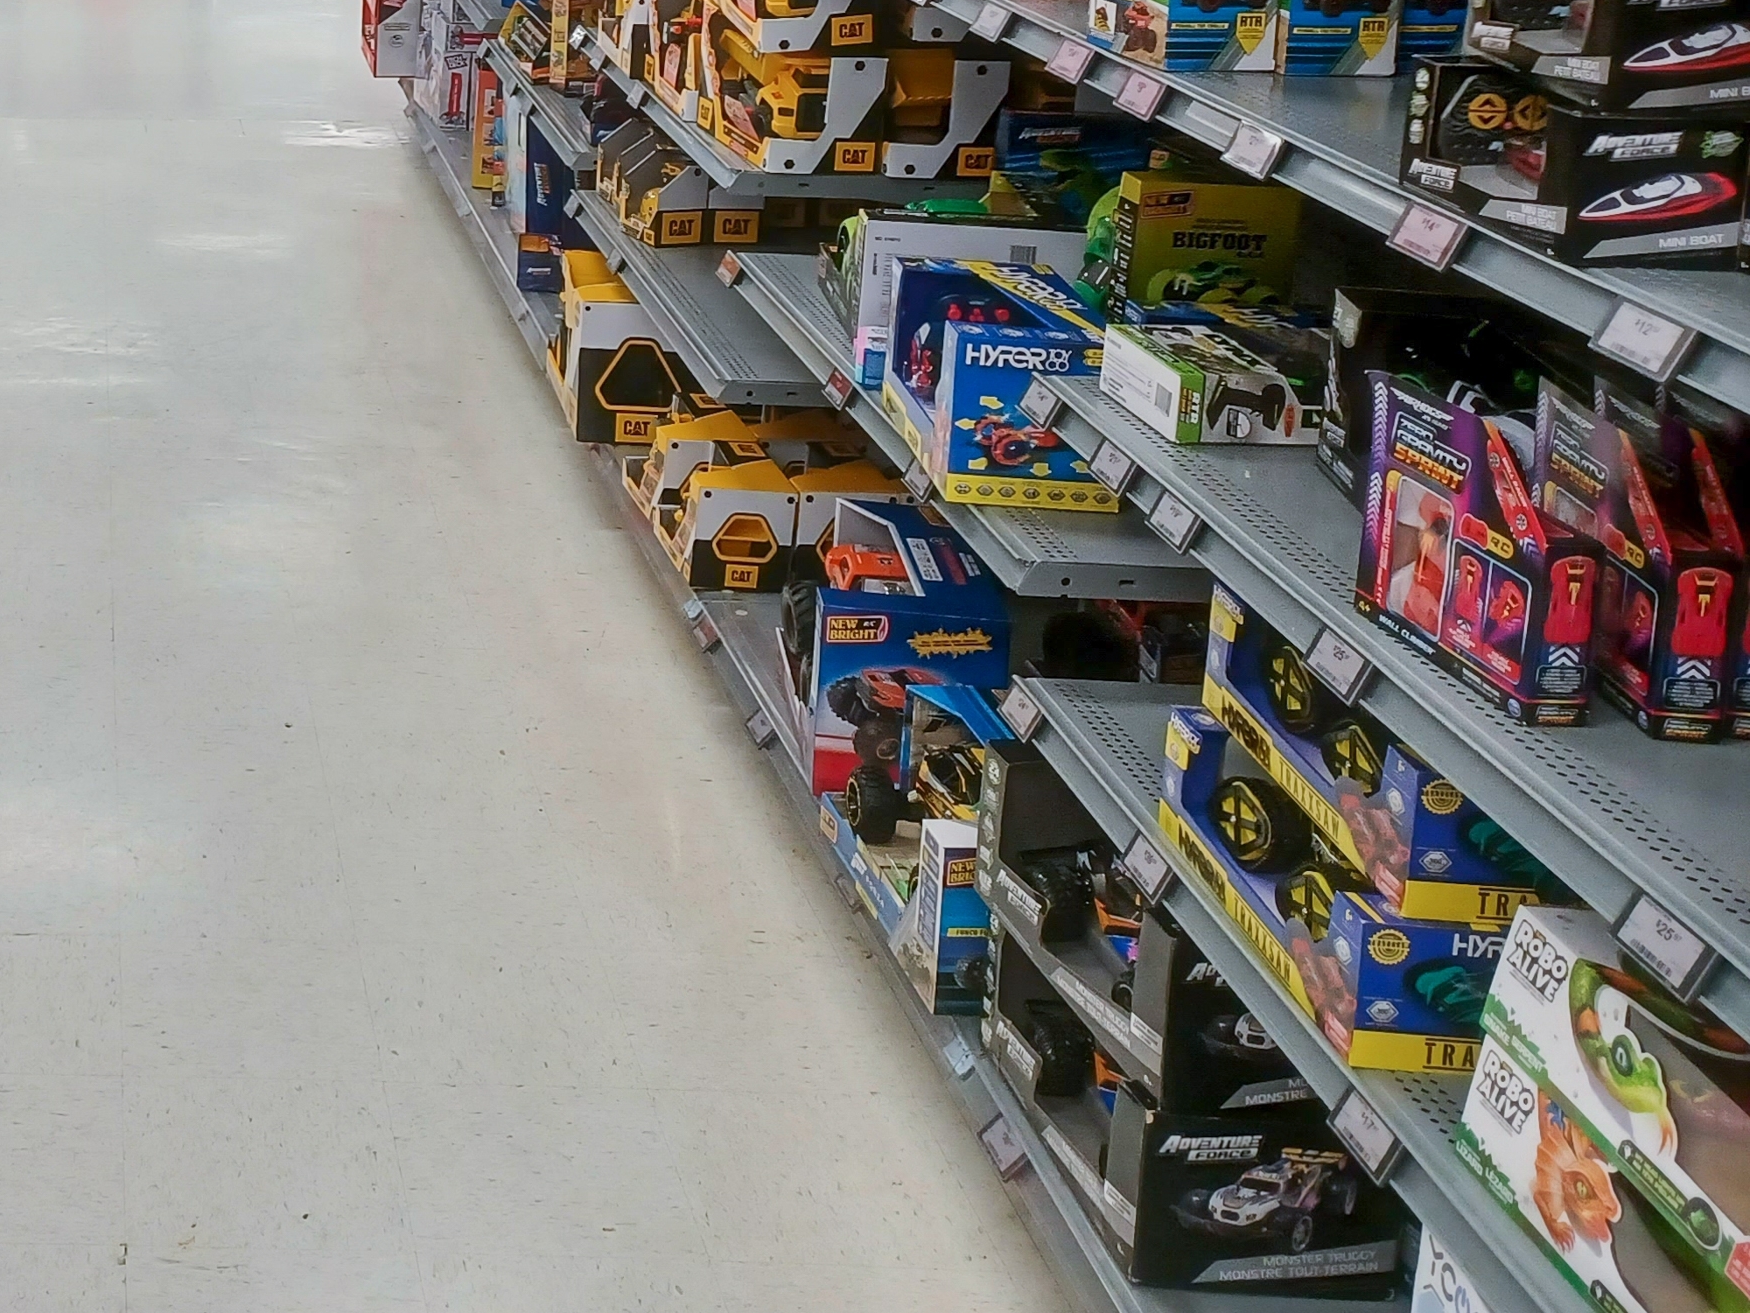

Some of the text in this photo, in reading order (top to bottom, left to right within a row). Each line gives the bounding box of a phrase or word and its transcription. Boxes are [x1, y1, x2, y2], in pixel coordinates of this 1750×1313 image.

[838, 21, 865, 38] CAT
[1239, 15, 1263, 29] RTR
[1361, 19, 1385, 33] RTR
[841, 148, 869, 165] CAT
[964, 152, 994, 169] CAT
[668, 218, 696, 236] CAT
[721, 218, 750, 235] CAT
[1172, 231, 1267, 251] BIGFOOT
[1658, 233, 1724, 248] MINI BOAT
[965, 343, 1047, 370] HYPER
[622, 418, 650, 436] CAT
[730, 569, 754, 583] CAT
[830, 618, 858, 630] NEW
[829, 628, 880, 642] BRIGHT
[1279, 760, 1341, 841] TRAXXSAW
[1233, 894, 1292, 984] TRAXXSAW
[1453, 933, 1505, 958] HYP
[1517, 919, 1569, 979] ROBO
[1507, 950, 1559, 1003] ALIVE
[1483, 1049, 1535, 1110] ROBO
[1476, 1079, 1524, 1134] ALIVE
[1159, 1133, 1263, 1156] ADVENTURE
[1195, 1148, 1253, 1160] FORCE
[1263, 1248, 1377, 1267] MONSTER TRUGGY
[1219, 1260, 1379, 1282] MONSTRE TOUT TERRAIN
